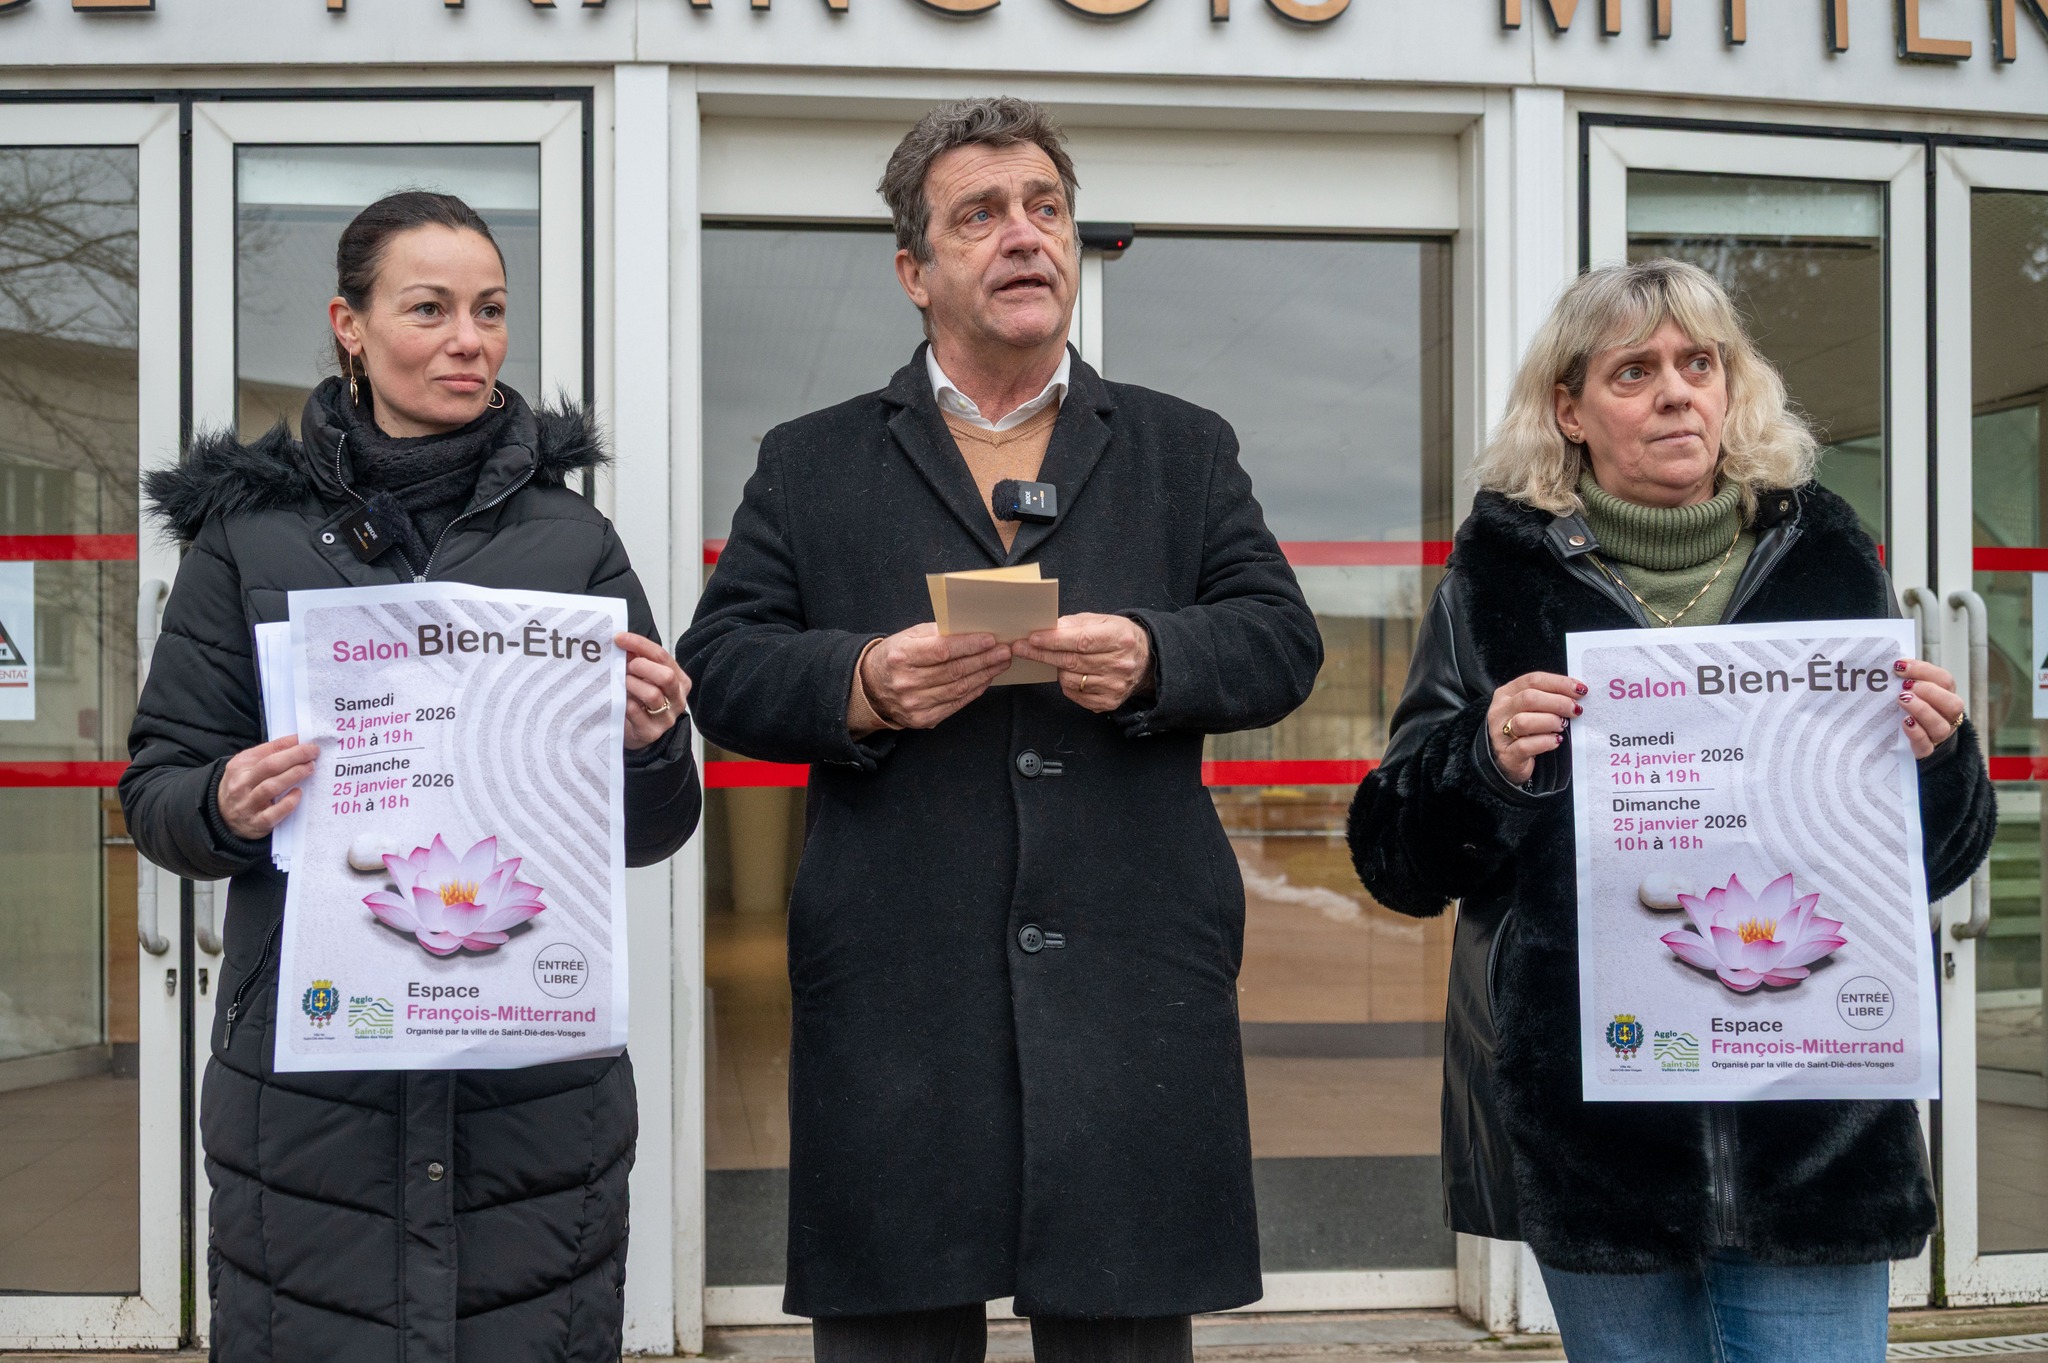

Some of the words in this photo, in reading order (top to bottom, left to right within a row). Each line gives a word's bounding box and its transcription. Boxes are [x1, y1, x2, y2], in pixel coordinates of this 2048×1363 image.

[333, 639, 408, 662] Salon
[417, 619, 601, 663] Bien-Être
[1609, 677, 1686, 700] Salon
[1697, 653, 1889, 695] Bien-Être
[335, 693, 394, 711] Samedi
[336, 717, 356, 731] 24
[358, 712, 411, 733] janvier
[416, 706, 456, 721] 2026
[370, 733, 378, 746] à
[1610, 731, 1674, 747] Samedi
[1610, 753, 1631, 766] 24
[1634, 751, 1696, 769] janvier
[1701, 748, 1744, 762] 2026
[335, 757, 410, 777] Dimanche
[1650, 771, 1660, 784] à
[333, 782, 352, 796] 25
[354, 777, 407, 798] janvier
[412, 773, 454, 787] 2026
[365, 798, 374, 811] à
[1613, 797, 1700, 812] Dimanche
[1613, 818, 1634, 831] 25
[1638, 816, 1699, 834] janvier
[1704, 814, 1747, 829] 2026
[1653, 836, 1663, 850] à
[538, 959, 584, 971] ENTRÉE
[544, 974, 578, 984] LIBRE
[408, 982, 480, 1000] Espace
[1841, 992, 1889, 1003] ENTRÉE
[350, 996, 373, 1004] Agglo
[407, 1004, 596, 1024] François-Mitterrand
[1848, 1007, 1883, 1016] LIBRE
[406, 1027, 444, 1036] Organisé
[445, 1029, 459, 1038] par
[501, 1029, 586, 1038] Saint-Dié-des-Vosges
[1654, 1030, 1678, 1039] Agglo
[1711, 1018, 1783, 1036] Espace
[1712, 1039, 1904, 1057] François-Mitterrand
[1711, 1061, 1749, 1069] Organisé
[1750, 1062, 1764, 1070] par
[1807, 1061, 1894, 1069] Saint-Dié-des-Vosges
